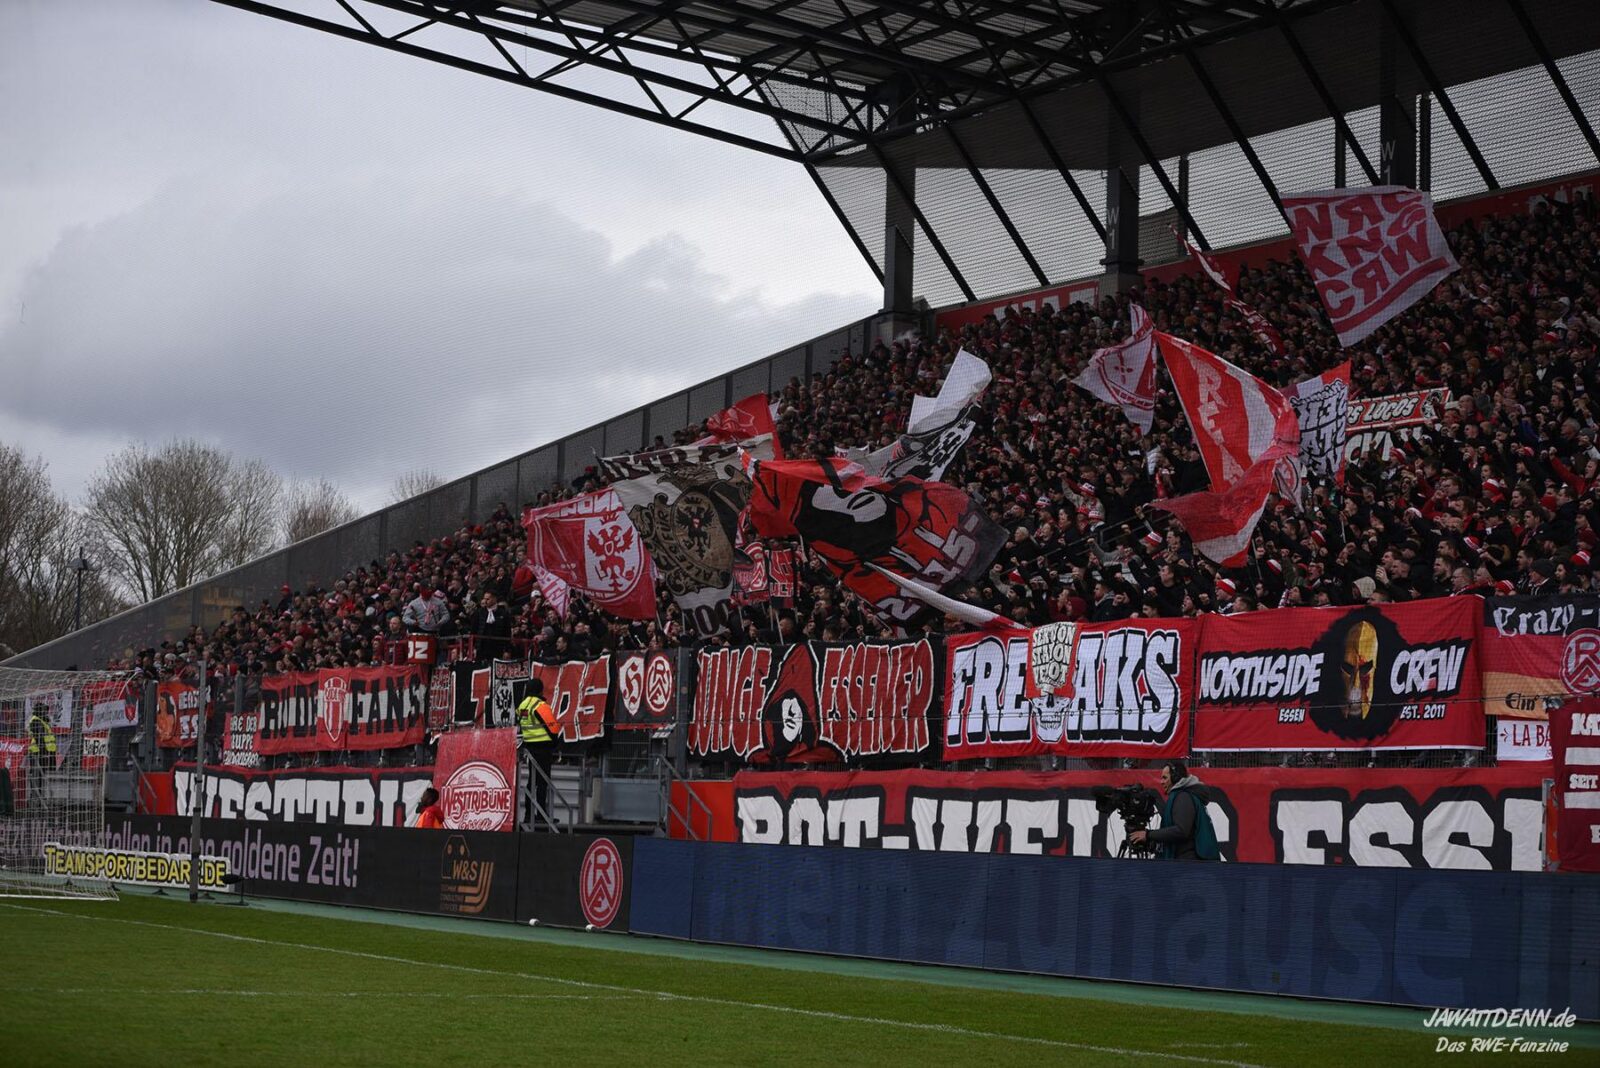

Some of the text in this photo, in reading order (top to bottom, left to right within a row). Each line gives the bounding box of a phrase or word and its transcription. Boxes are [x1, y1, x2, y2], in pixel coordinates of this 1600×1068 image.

[1381, 140, 1396, 161] W
[1107, 206, 1120, 225] W
[1109, 229, 1116, 250] 1
[1363, 397, 1419, 424] LOCOS
[1199, 645, 1465, 700] NORTHSIDE CREW
[687, 639, 934, 756] JUNGE ESSENER
[947, 628, 1181, 746] FREAKS
[350, 672, 422, 737] FANS
[1278, 703, 1446, 723] ESSEN EST. 2011
[1512, 723, 1531, 746] LA
[44, 844, 229, 886] TEAMSPORTBEDAR.DE
[306, 832, 360, 888] Zeit!
[452, 860, 479, 881] W&S
